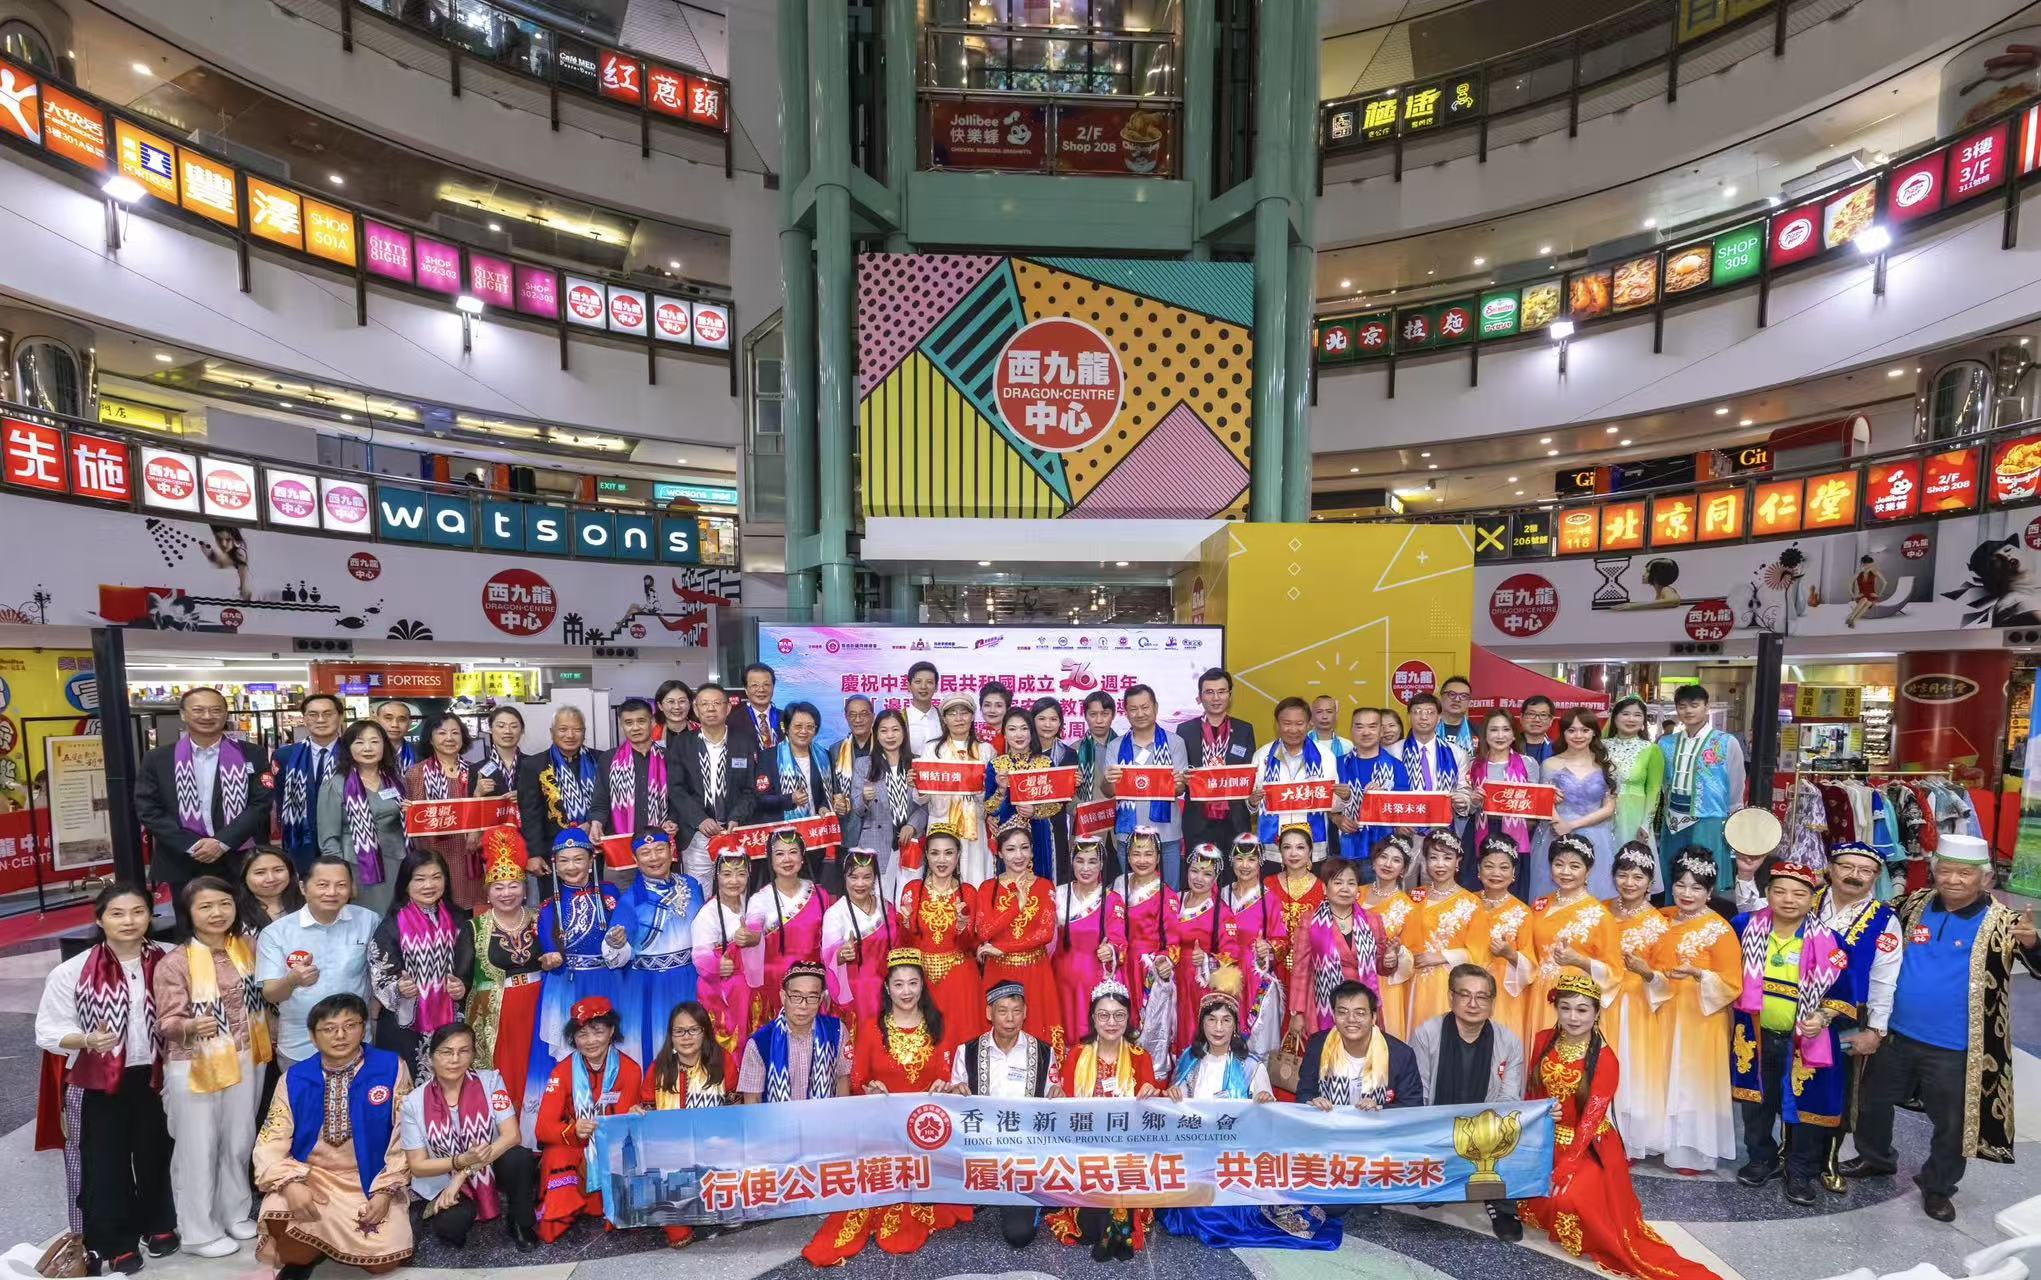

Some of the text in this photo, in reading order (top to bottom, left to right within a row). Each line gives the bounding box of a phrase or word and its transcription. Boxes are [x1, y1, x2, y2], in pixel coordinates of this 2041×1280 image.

[950, 114, 999, 127] Jollibee
[950, 128, 999, 144] 快樂蜂
[1076, 127, 1103, 141] 2/F
[1062, 142, 1116, 153] Shop 208
[1961, 136, 1993, 163] 3樓
[1959, 157, 1992, 183] 3/F
[310, 212, 349, 233] SHOP
[1718, 238, 1758, 259] SHOP
[425, 255, 452, 268] SHOP
[1724, 254, 1748, 271] 309
[524, 282, 550, 294] SHOP
[1008, 350, 1111, 386] 西九龍
[1025, 400, 1093, 435] 中心
[9, 429, 127, 495] 先施
[600, 482, 616, 490] EXIT
[1938, 473, 1960, 485] 2/F
[157, 482, 185, 496] 中心
[1926, 480, 1970, 494] Shop 208
[215, 493, 242, 507] 中心
[281, 503, 306, 515] 中心
[335, 508, 359, 519] 中心
[1605, 479, 1849, 545] 北京同仁堂
[381, 501, 689, 552] watsons
[1903, 538, 1929, 549] 西九龍
[350, 557, 379, 568] 西九龍
[355, 570, 374, 579] 中心
[487, 582, 552, 605] 西九龍
[1495, 587, 1554, 607] 西九龍
[500, 611, 542, 631] 中心
[1689, 609, 1731, 622] 西九龍
[1504, 615, 1542, 632] 中心
[1695, 626, 1722, 639] 中心
[387, 676, 441, 686] FORTRESS
[1395, 671, 1433, 684] 西九龍
[1580, 701, 1605, 711] CENTRE
[1207, 777, 1249, 789] 協力創新
[1382, 803, 1426, 814] 共築未來
[960, 1109, 1238, 1133] 香港新疆同鄉總會
[964, 1132, 1238, 1146] HONG KONG XINJIANG PROVINCE GENERAL ASSOCIATION
[701, 1152, 1445, 1211] 行使公民權利 履行公民責任 共創美好未來
